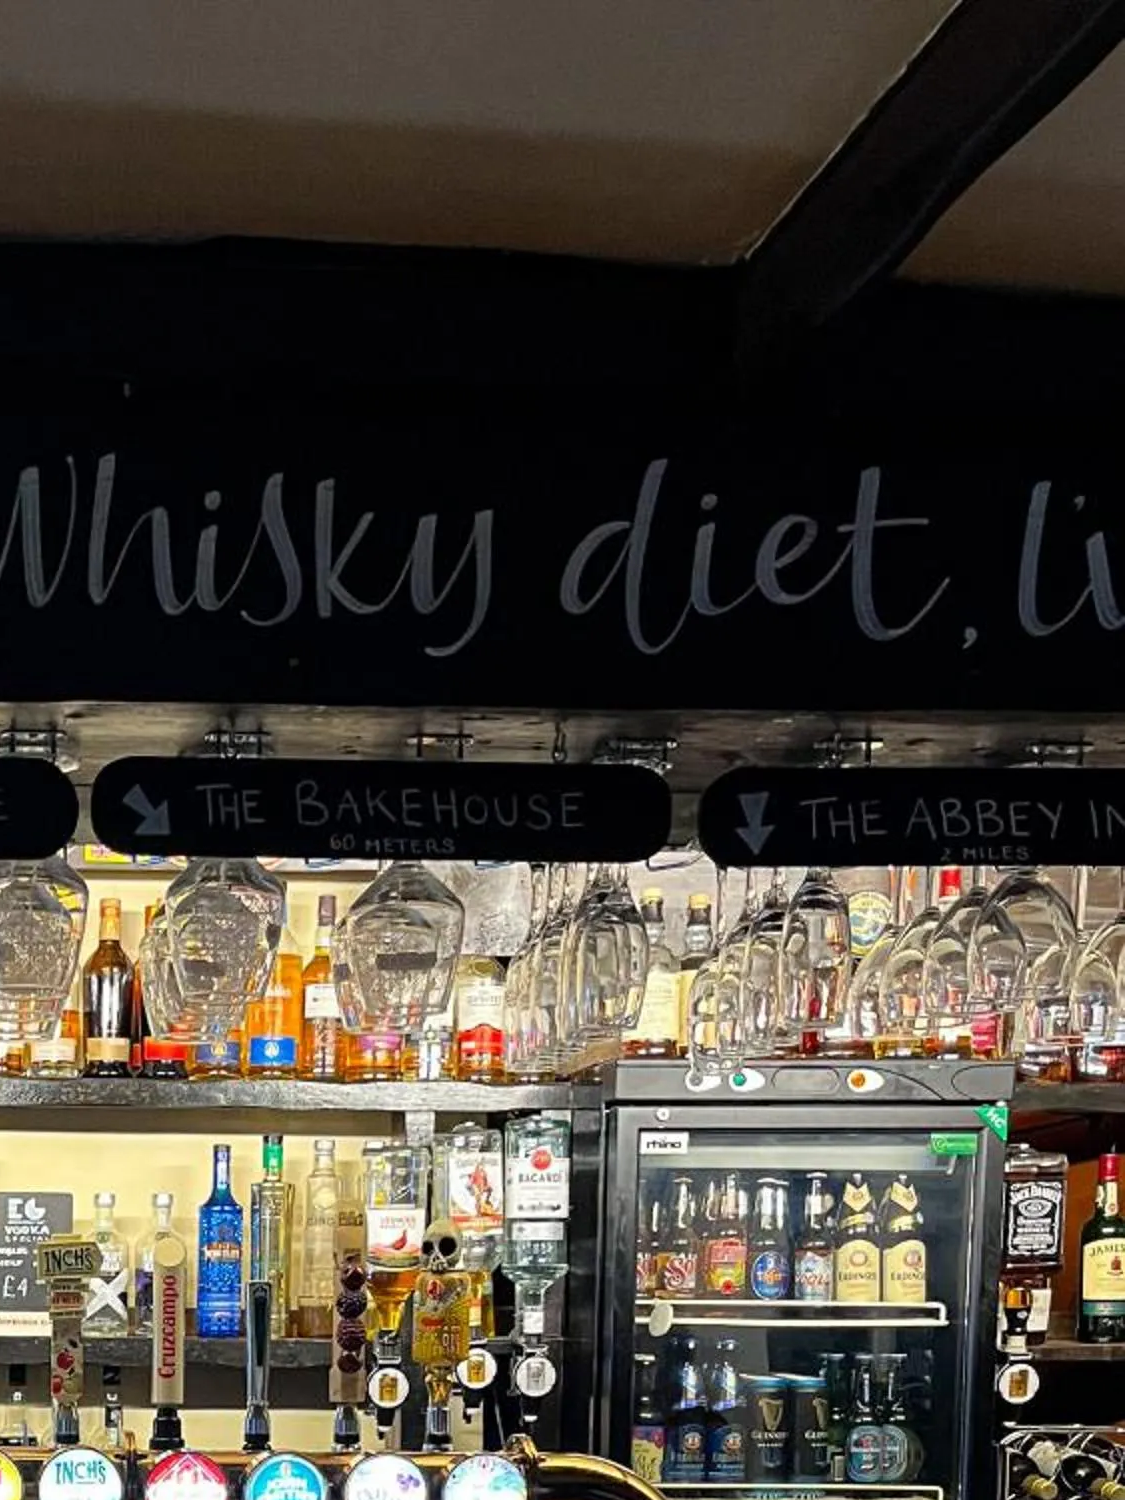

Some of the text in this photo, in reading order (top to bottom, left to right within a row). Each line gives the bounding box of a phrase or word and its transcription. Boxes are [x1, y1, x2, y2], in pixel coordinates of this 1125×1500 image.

[195, 780, 586, 831] THE BAKEHOUSE
[798, 797, 888, 844] THE
[904, 798, 1064, 841] ABBEY
[329, 834, 456, 855] 60 METERS
[940, 846, 1031, 862] 2 MILES
[3, 1274, 28, 1299] £4
[157, 1274, 180, 1380] Cruzcampo
[55, 1459, 106, 1485] INCH'S
